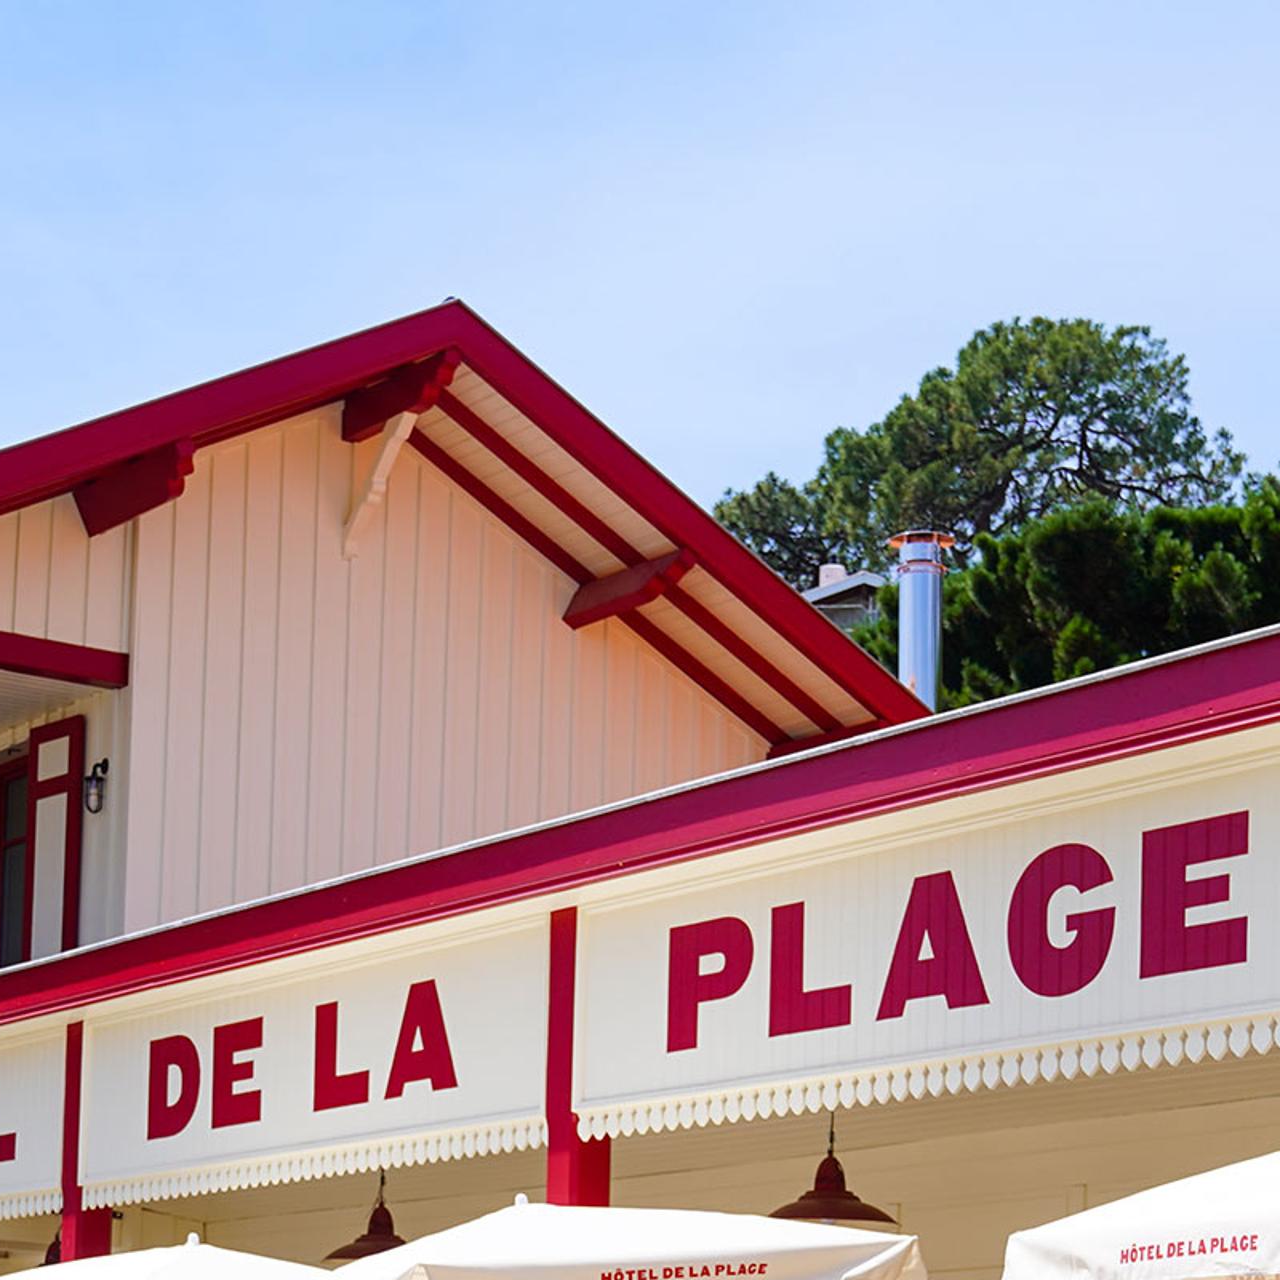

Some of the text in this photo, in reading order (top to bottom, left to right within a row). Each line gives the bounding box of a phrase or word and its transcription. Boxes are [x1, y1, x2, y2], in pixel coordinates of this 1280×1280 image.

[147, 1016, 264, 1141] DE
[313, 979, 459, 1112] LA
[666, 809, 1250, 1053] PLAGE
[1119, 1234, 1259, 1264] HÔTEL DE LA PLAGE
[662, 1266, 684, 1280] DE
[689, 1266, 711, 1278] LA
[715, 1263, 768, 1277] PLAGE
